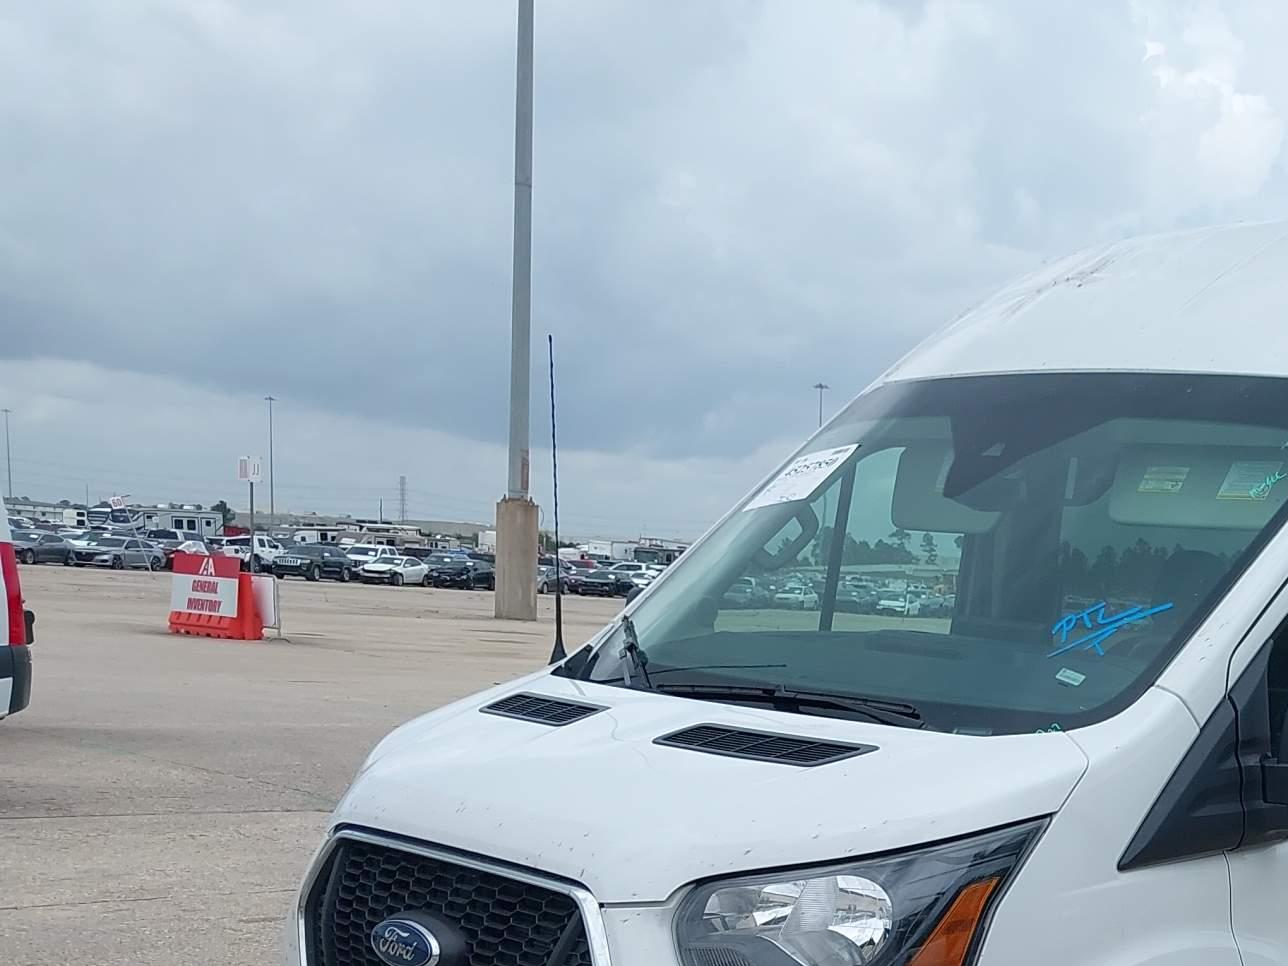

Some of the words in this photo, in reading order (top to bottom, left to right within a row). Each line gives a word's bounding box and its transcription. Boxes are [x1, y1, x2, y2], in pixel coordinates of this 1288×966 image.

[191, 579, 219, 594] GENERAL
[186, 597, 222, 613] INVENTORY
[380, 926, 418, 961] Ford
